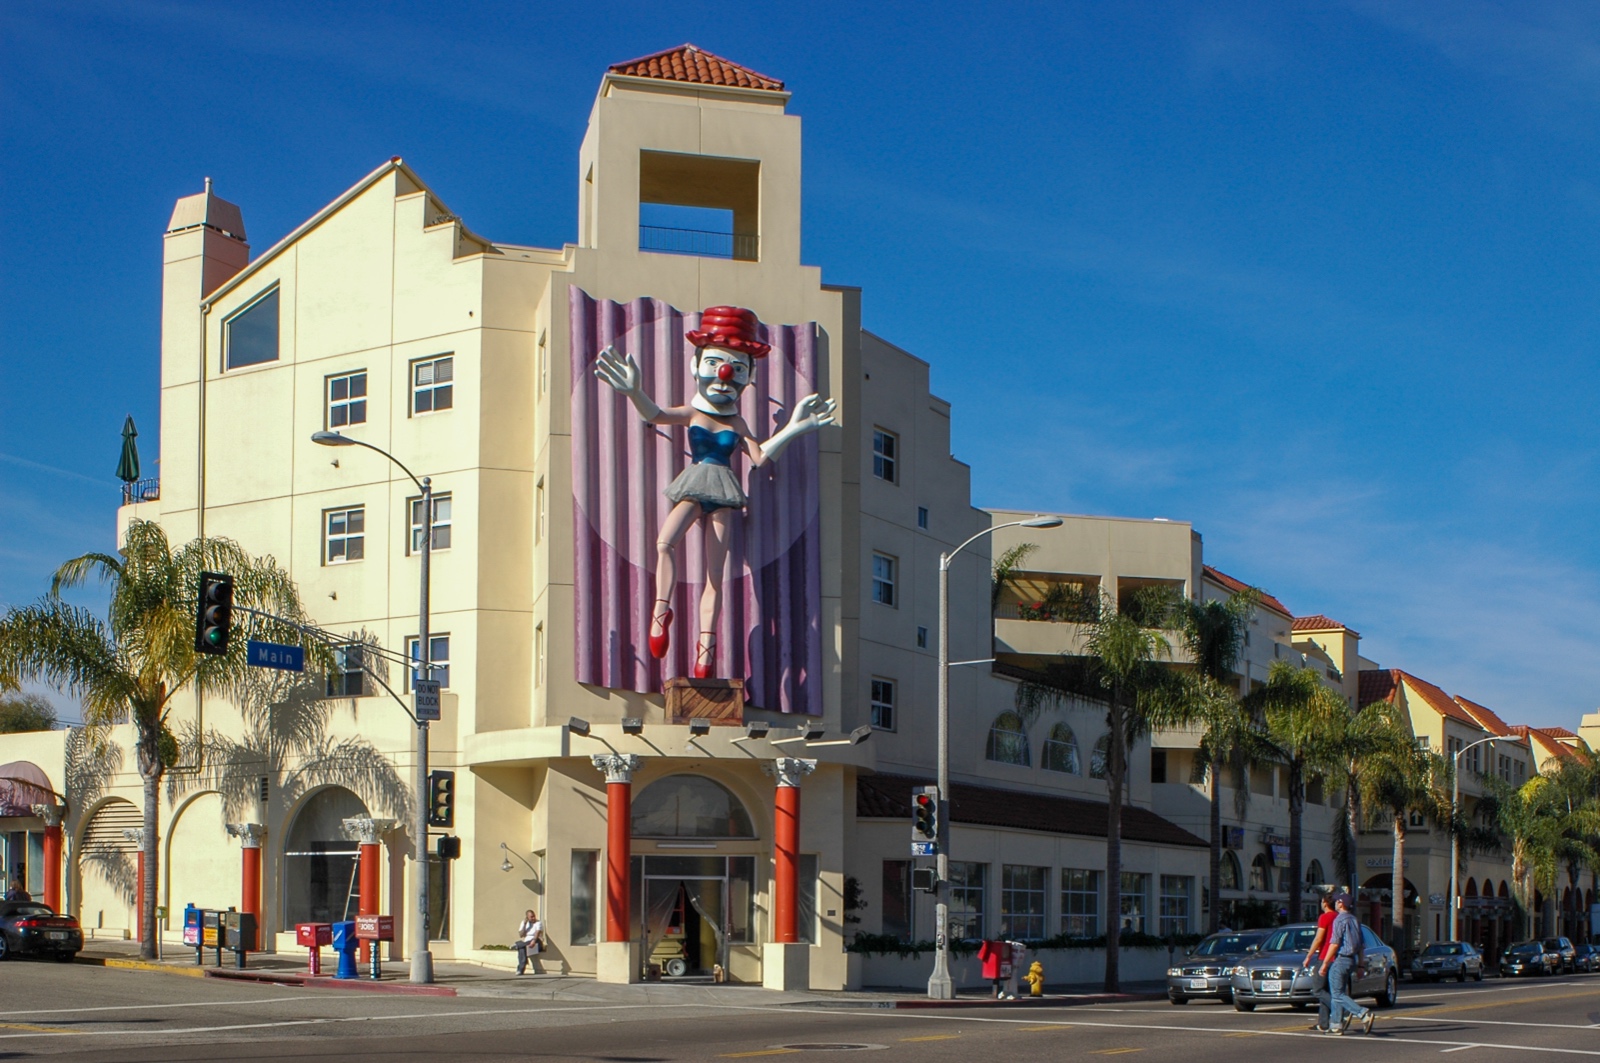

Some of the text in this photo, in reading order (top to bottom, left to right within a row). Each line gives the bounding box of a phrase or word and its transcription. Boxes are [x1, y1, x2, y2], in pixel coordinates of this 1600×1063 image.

[259, 648, 292, 664] Main
[418, 684, 438, 694] DO NOT
[418, 696, 438, 706] BLOCK
[1365, 856, 1409, 867] exhe
